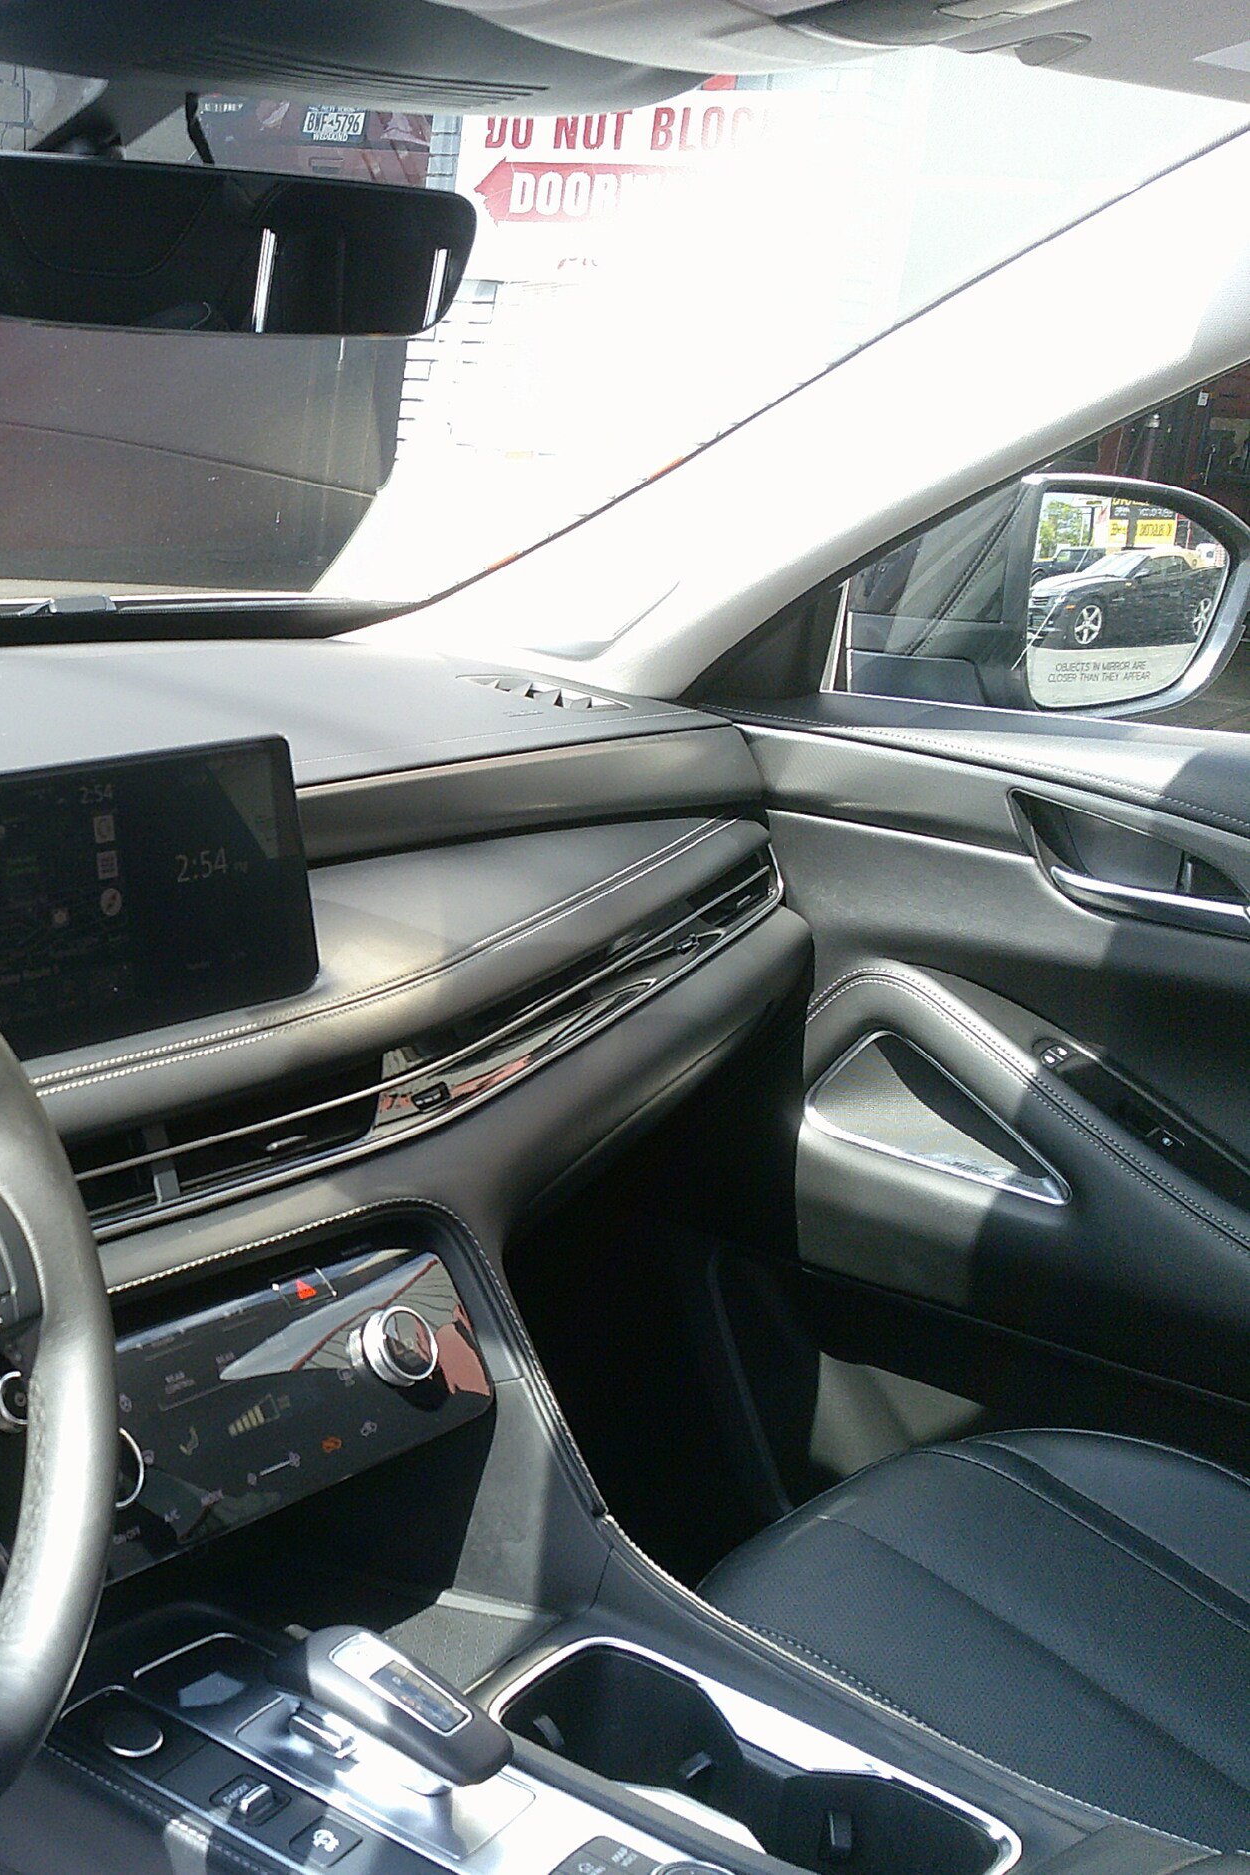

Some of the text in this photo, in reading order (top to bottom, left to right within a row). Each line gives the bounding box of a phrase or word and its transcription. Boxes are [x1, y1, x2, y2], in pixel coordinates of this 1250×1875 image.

[485, 115, 534, 149] DO
[553, 110, 633, 151] NOT
[1047, 670, 1151, 683] CLOSER THAN THEY APPEAR
[1055, 660, 1147, 674] OBJECTS IN MIRROR ARE
[175, 847, 228, 883] 2:54
